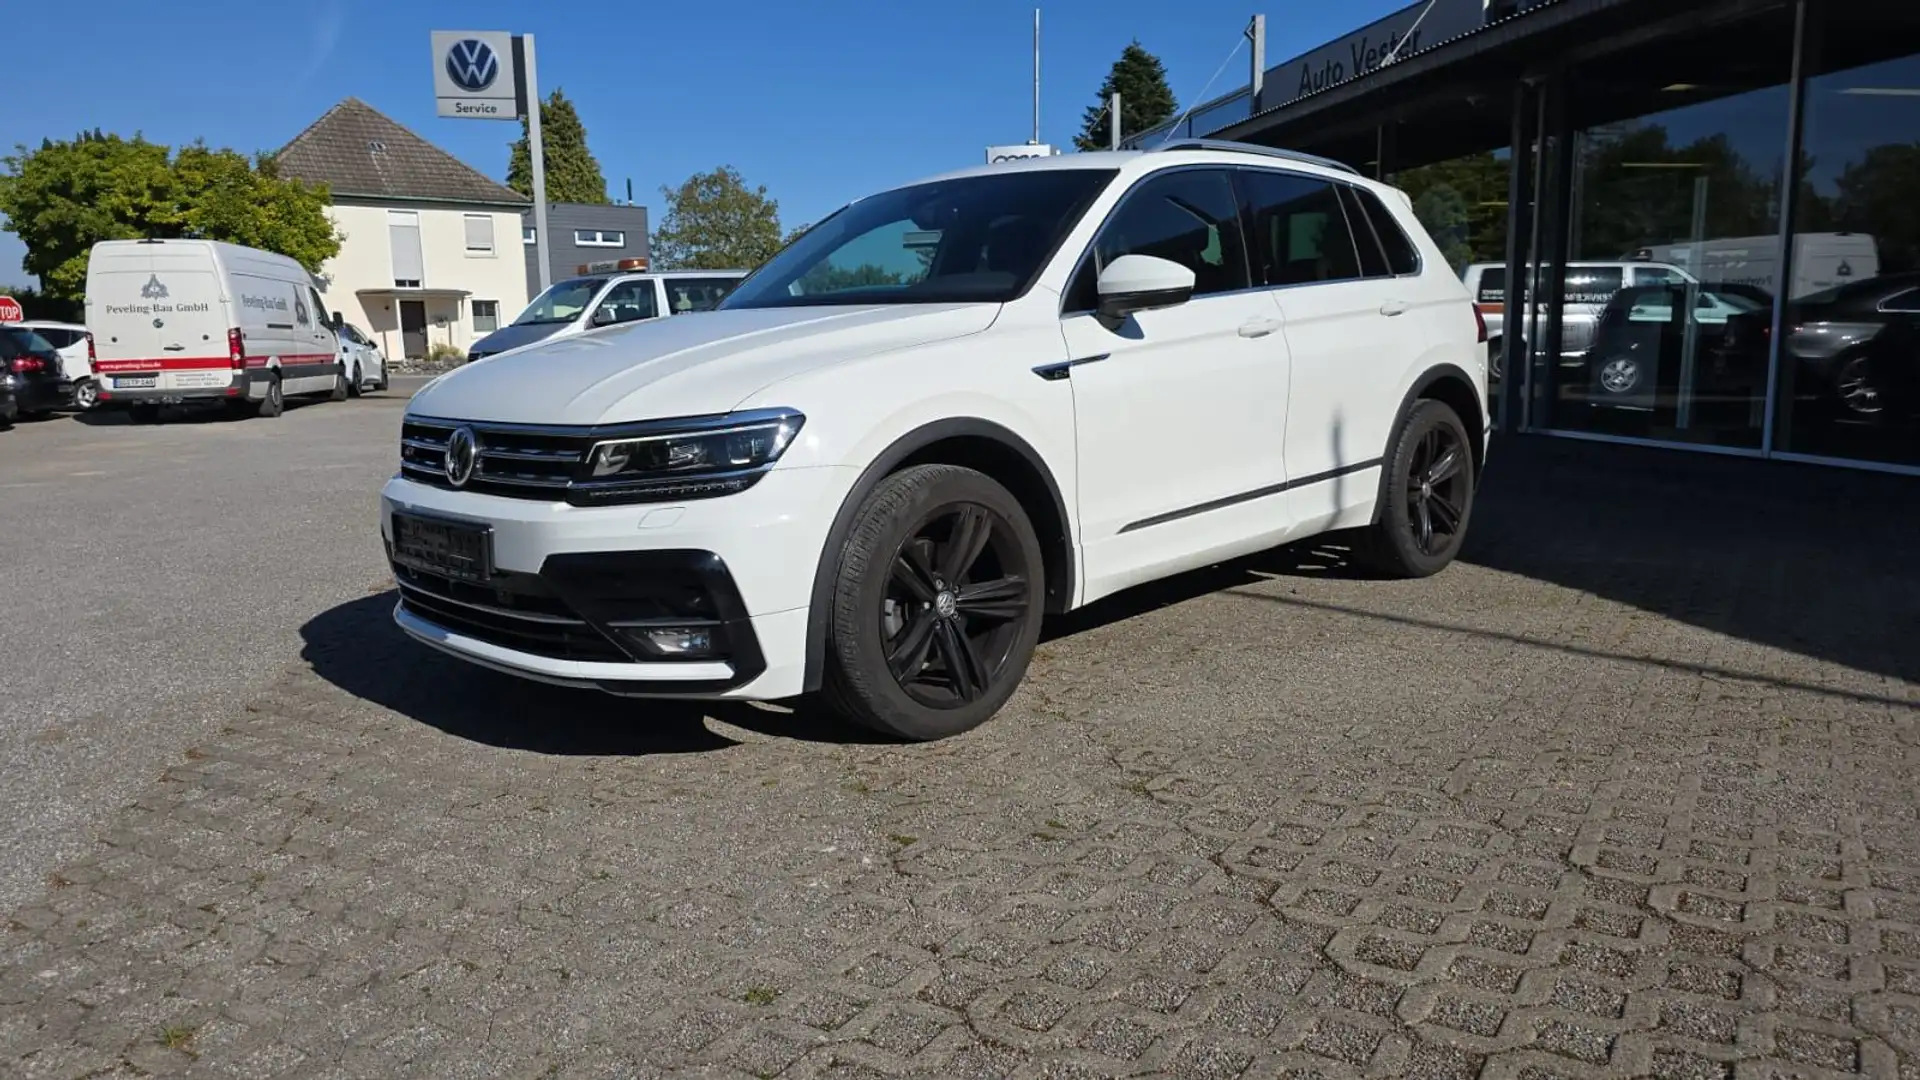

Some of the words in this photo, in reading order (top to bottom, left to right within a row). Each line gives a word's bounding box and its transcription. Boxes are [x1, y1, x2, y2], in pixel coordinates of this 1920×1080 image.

[1299, 59, 1344, 96] Auto
[1351, 29, 1421, 74] Vester
[455, 102, 497, 114] Service
[0, 306, 18, 319] TOP
[106, 303, 173, 314] Peveling-Bau
[176, 302, 209, 312] GmbH
